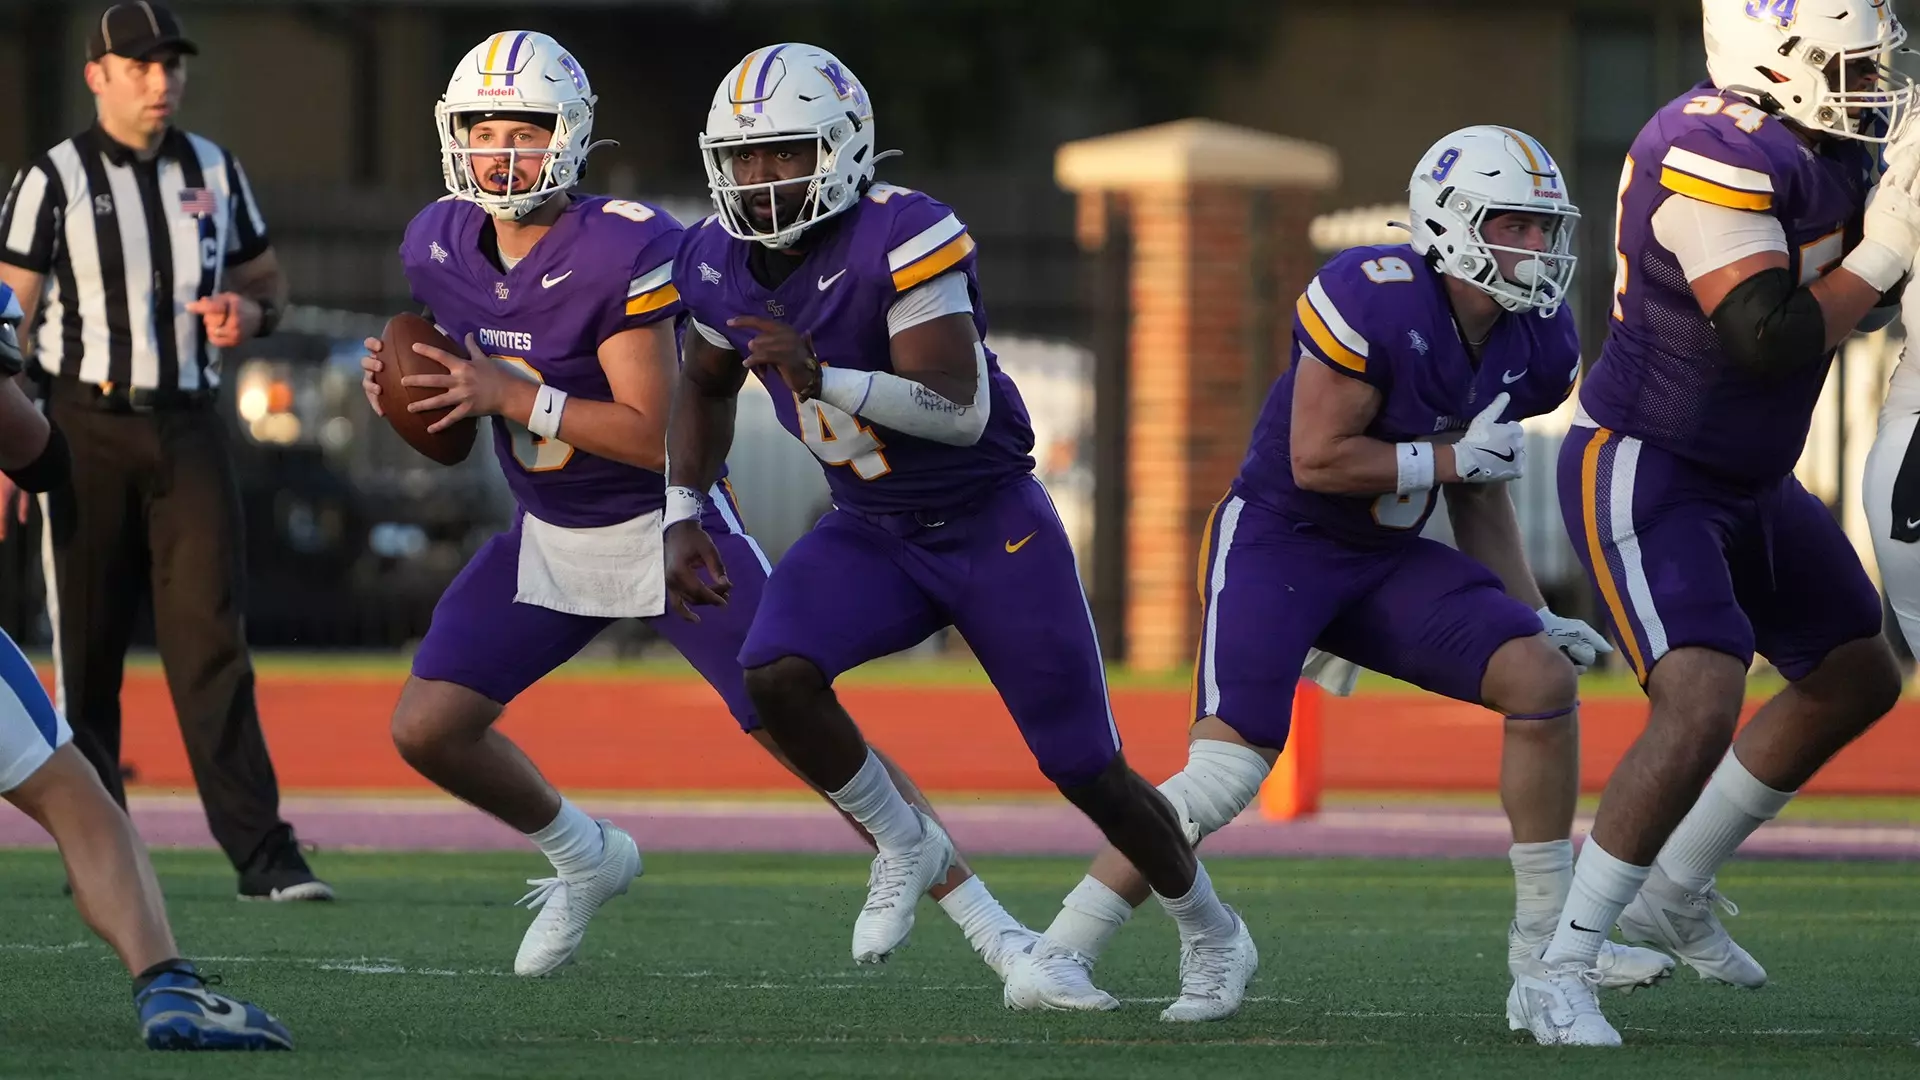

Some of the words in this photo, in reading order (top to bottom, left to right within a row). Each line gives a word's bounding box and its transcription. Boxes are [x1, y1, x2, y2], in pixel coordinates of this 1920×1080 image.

[477, 88, 515, 96] Riddell
[1431, 147, 1462, 184] 9
[95, 194, 112, 215] S
[602, 199, 656, 223] 6
[202, 238, 217, 269] C
[1361, 256, 1414, 284] 9
[479, 327, 532, 351] COYOTES
[790, 362, 892, 481] 4
